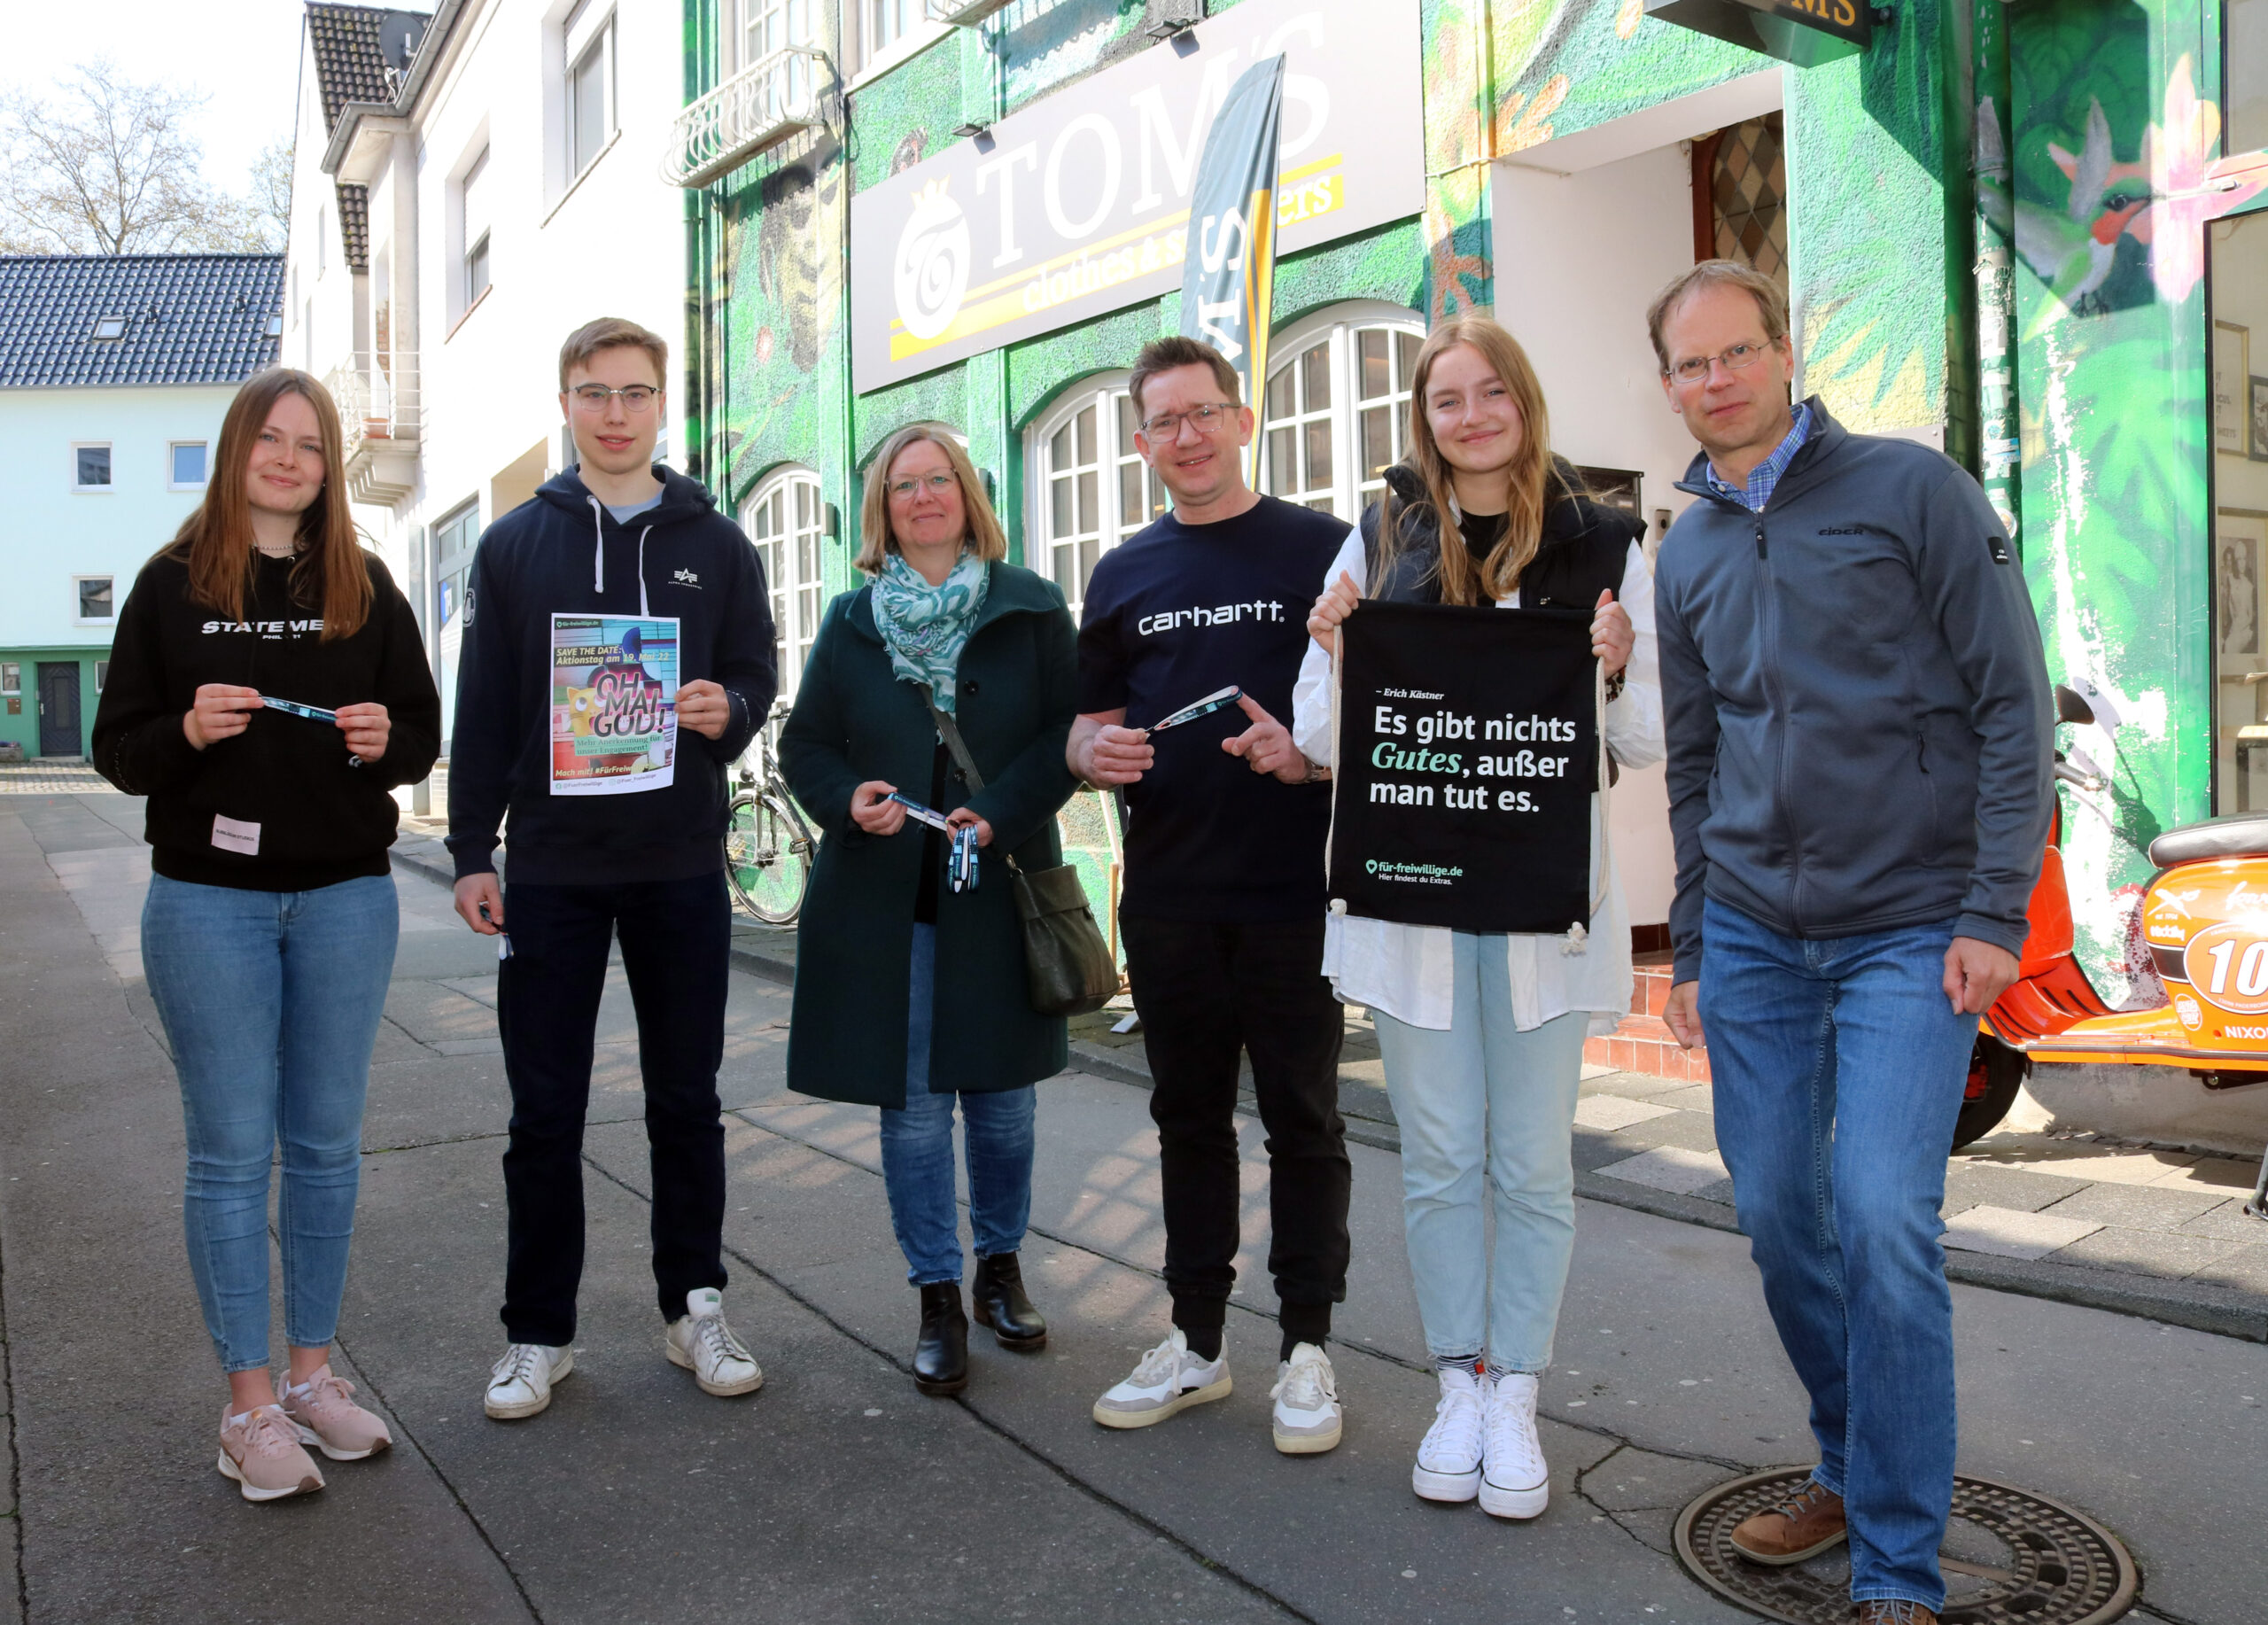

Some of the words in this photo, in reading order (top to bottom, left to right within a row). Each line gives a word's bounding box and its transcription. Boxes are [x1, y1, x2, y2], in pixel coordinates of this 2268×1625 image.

[976, 11, 1332, 268] TOM'S
[1022, 237, 1137, 314] clothes
[1141, 234, 1164, 272] &
[555, 655, 604, 665] Aktionstag
[656, 652, 671, 661] 22
[556, 647, 578, 657] SAVE
[578, 646, 597, 656] THE
[597, 645, 622, 655] DATE:
[596, 672, 642, 698] OH
[1382, 687, 1408, 699] Erich
[1409, 688, 1445, 701] Kästner
[604, 688, 661, 717] MAI
[594, 708, 666, 738] GOD!
[1374, 706, 1407, 735] Es
[1416, 711, 1476, 744] gibt
[1484, 713, 1577, 743] nichts
[576, 737, 596, 746] Mehr
[598, 735, 649, 747] Anerkennung
[599, 743, 649, 754] Engagement!
[1371, 741, 1471, 778] Gutes,
[1476, 750, 1570, 778] außer
[577, 767, 594, 777] mit!
[1369, 782, 1434, 807] man
[1443, 785, 1488, 810] tut
[1497, 789, 1541, 812] es.
[1378, 860, 1464, 877] für-freiwillige.de
[1379, 873, 1393, 882] Hier
[1394, 874, 1418, 883] findest
[1418, 875, 1429, 883] du
[1429, 876, 1453, 885] Extras.
[2208, 938, 2268, 997] 10
[2225, 1025, 2268, 1039] NIXO
